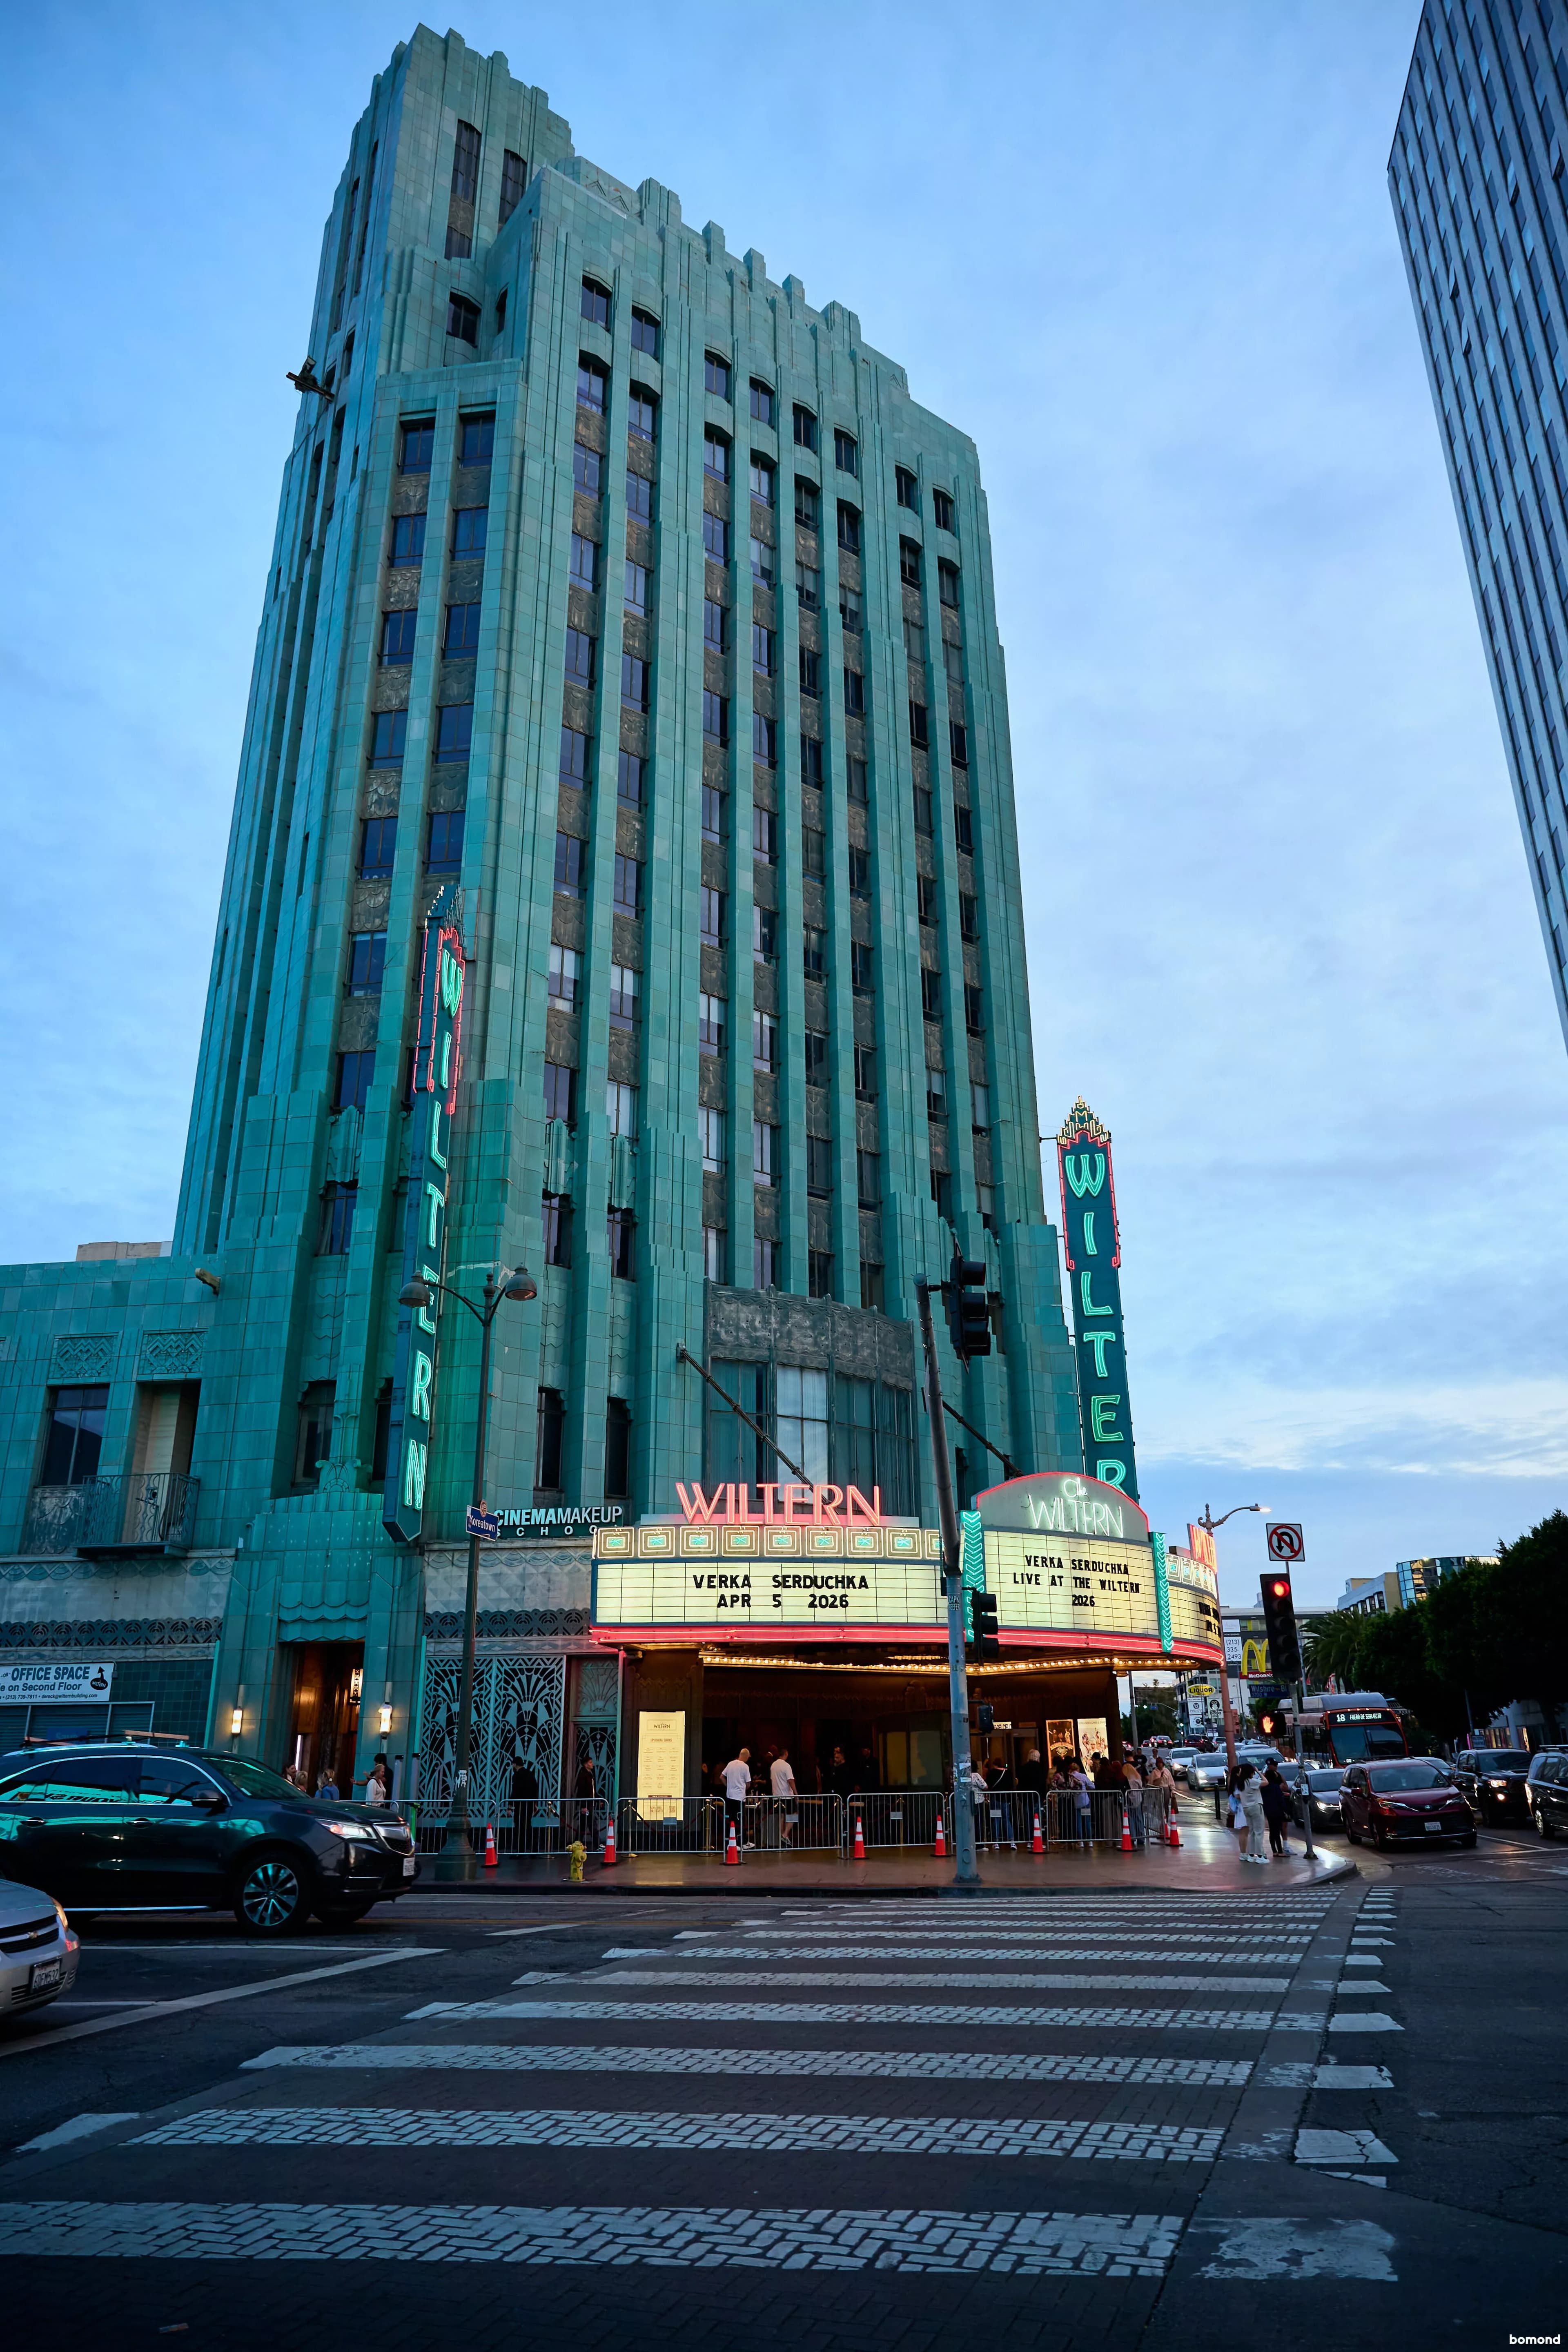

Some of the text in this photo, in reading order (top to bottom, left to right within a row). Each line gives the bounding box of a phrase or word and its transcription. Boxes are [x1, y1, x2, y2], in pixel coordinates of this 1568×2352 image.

[405, 948, 463, 1511] WILTERN
[675, 1482, 880, 1526] WILTERN
[470, 1515, 495, 1532] Koreatown
[1027, 1494, 1124, 1538] WILTERN
[1025, 1555, 1129, 1575] VERKA SERDUCHKA
[693, 1575, 869, 1589] VERKA SERDUCHKA
[1013, 1572, 1140, 1593] LIVE AT THE WILTERN
[717, 1594, 849, 1608] APR 5 2026
[1072, 1594, 1095, 1607] 2026
[11, 1667, 51, 1681] OFFICE
[54, 1666, 90, 1680] SPACE
[22, 1682, 56, 1691] Second
[58, 1682, 82, 1690] Floor
